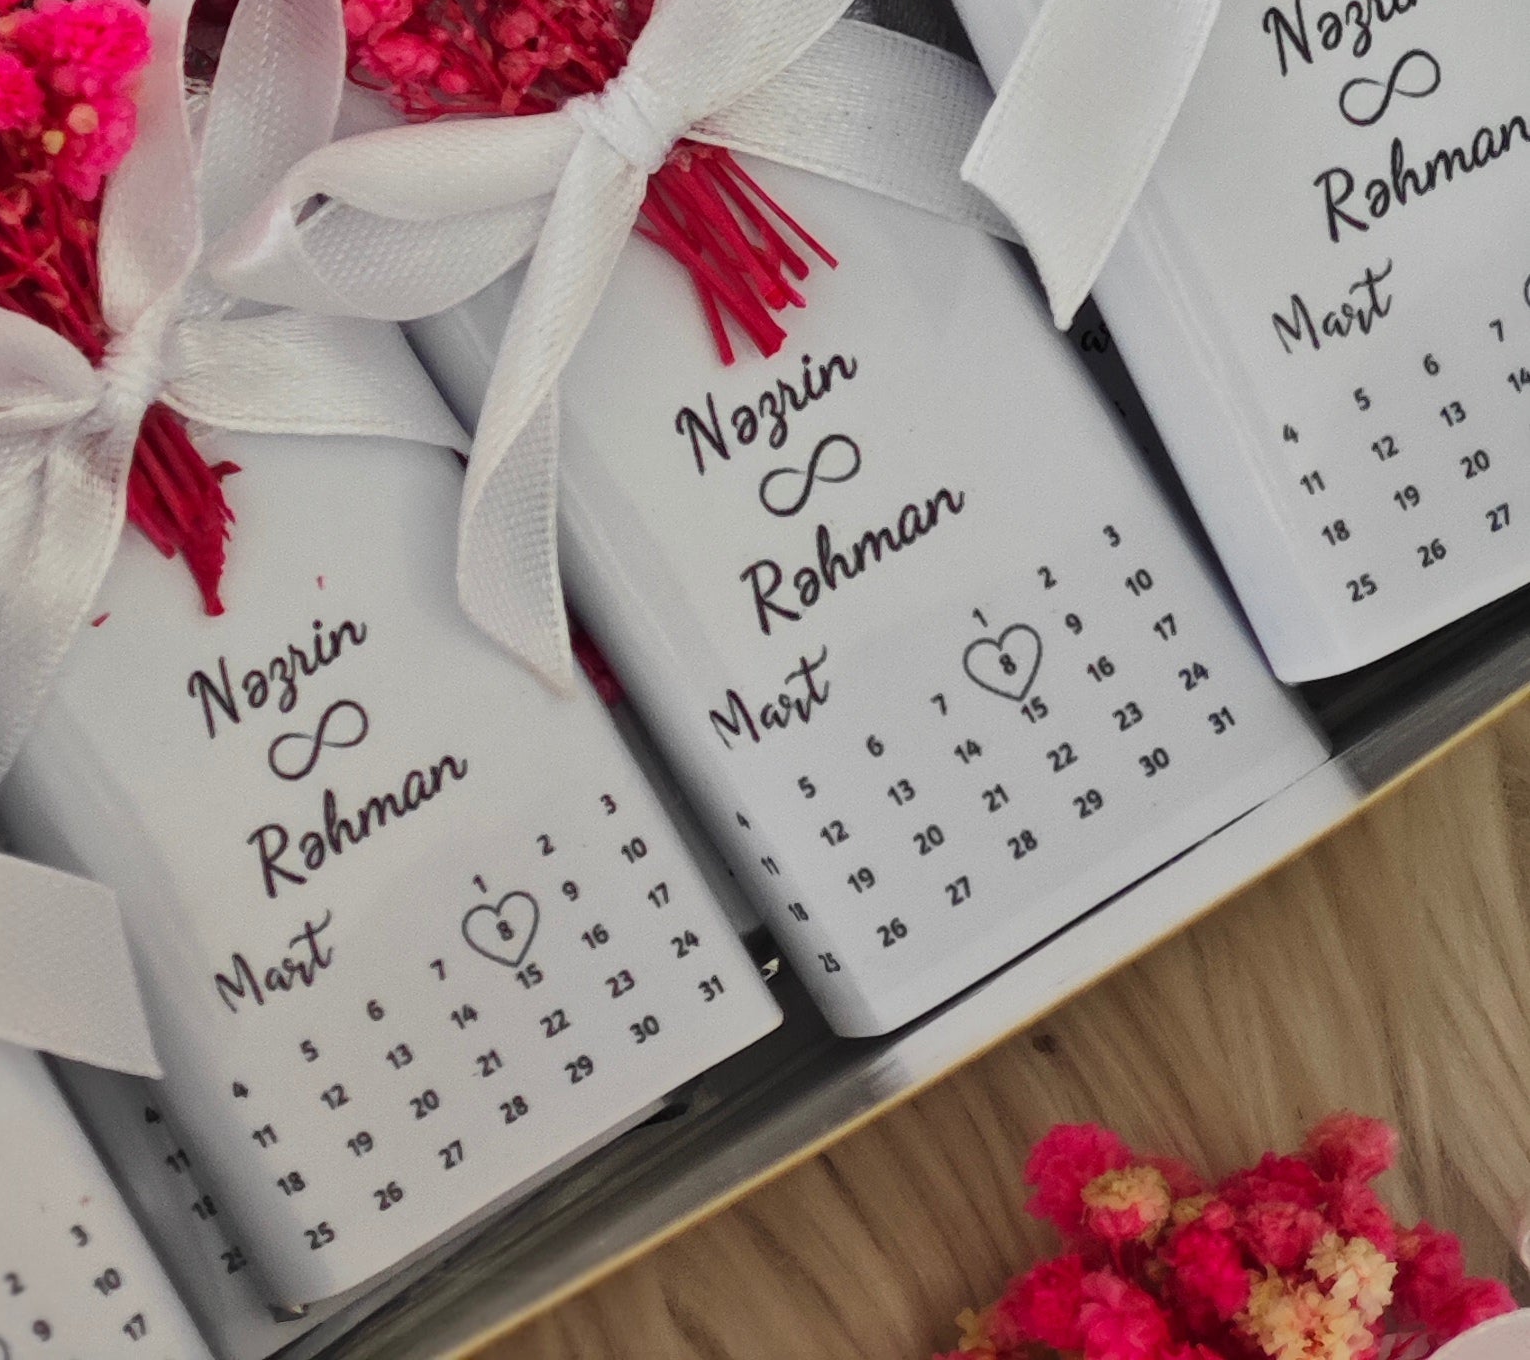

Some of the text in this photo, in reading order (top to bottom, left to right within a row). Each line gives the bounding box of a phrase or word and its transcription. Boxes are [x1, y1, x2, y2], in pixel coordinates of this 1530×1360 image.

[1313, 116, 1530, 244] Rəhman
[1272, 258, 1392, 354] Mart
[675, 353, 858, 476] Nəzrin
[1283, 319, 1504, 443] 4 5 6 7
[1300, 401, 1466, 495] 11 12 13
[1321, 449, 1490, 546] 18 19 20
[739, 487, 965, 636] Rəhman
[972, 525, 1121, 628] 1 2 3
[1346, 502, 1510, 602] 25 26 27
[187, 619, 367, 739] Nəzrin
[709, 644, 830, 750] Mart
[797, 776, 817, 799] 5
[866, 734, 885, 758] 6
[930, 693, 947, 716] 7
[998, 653, 1017, 676] 8
[1065, 613, 1083, 635] 9
[1125, 569, 1154, 596] 10
[246, 755, 468, 899] Rəhman
[847, 867, 876, 893] 19
[913, 824, 945, 856] 20
[982, 784, 1010, 813] 21
[1046, 742, 1078, 773] 22
[1112, 701, 1144, 732] 23
[1178, 662, 1209, 691] 24
[214, 909, 333, 1014] Mart
[232, 836, 647, 1098] 4 5 6 7 8 9 10
[252, 882, 670, 1148] 11 12 13 14 15 16 17
[4, 1272, 24, 1296] 2
[93, 1268, 122, 1297] 10
[122, 1313, 147, 1341] 17
